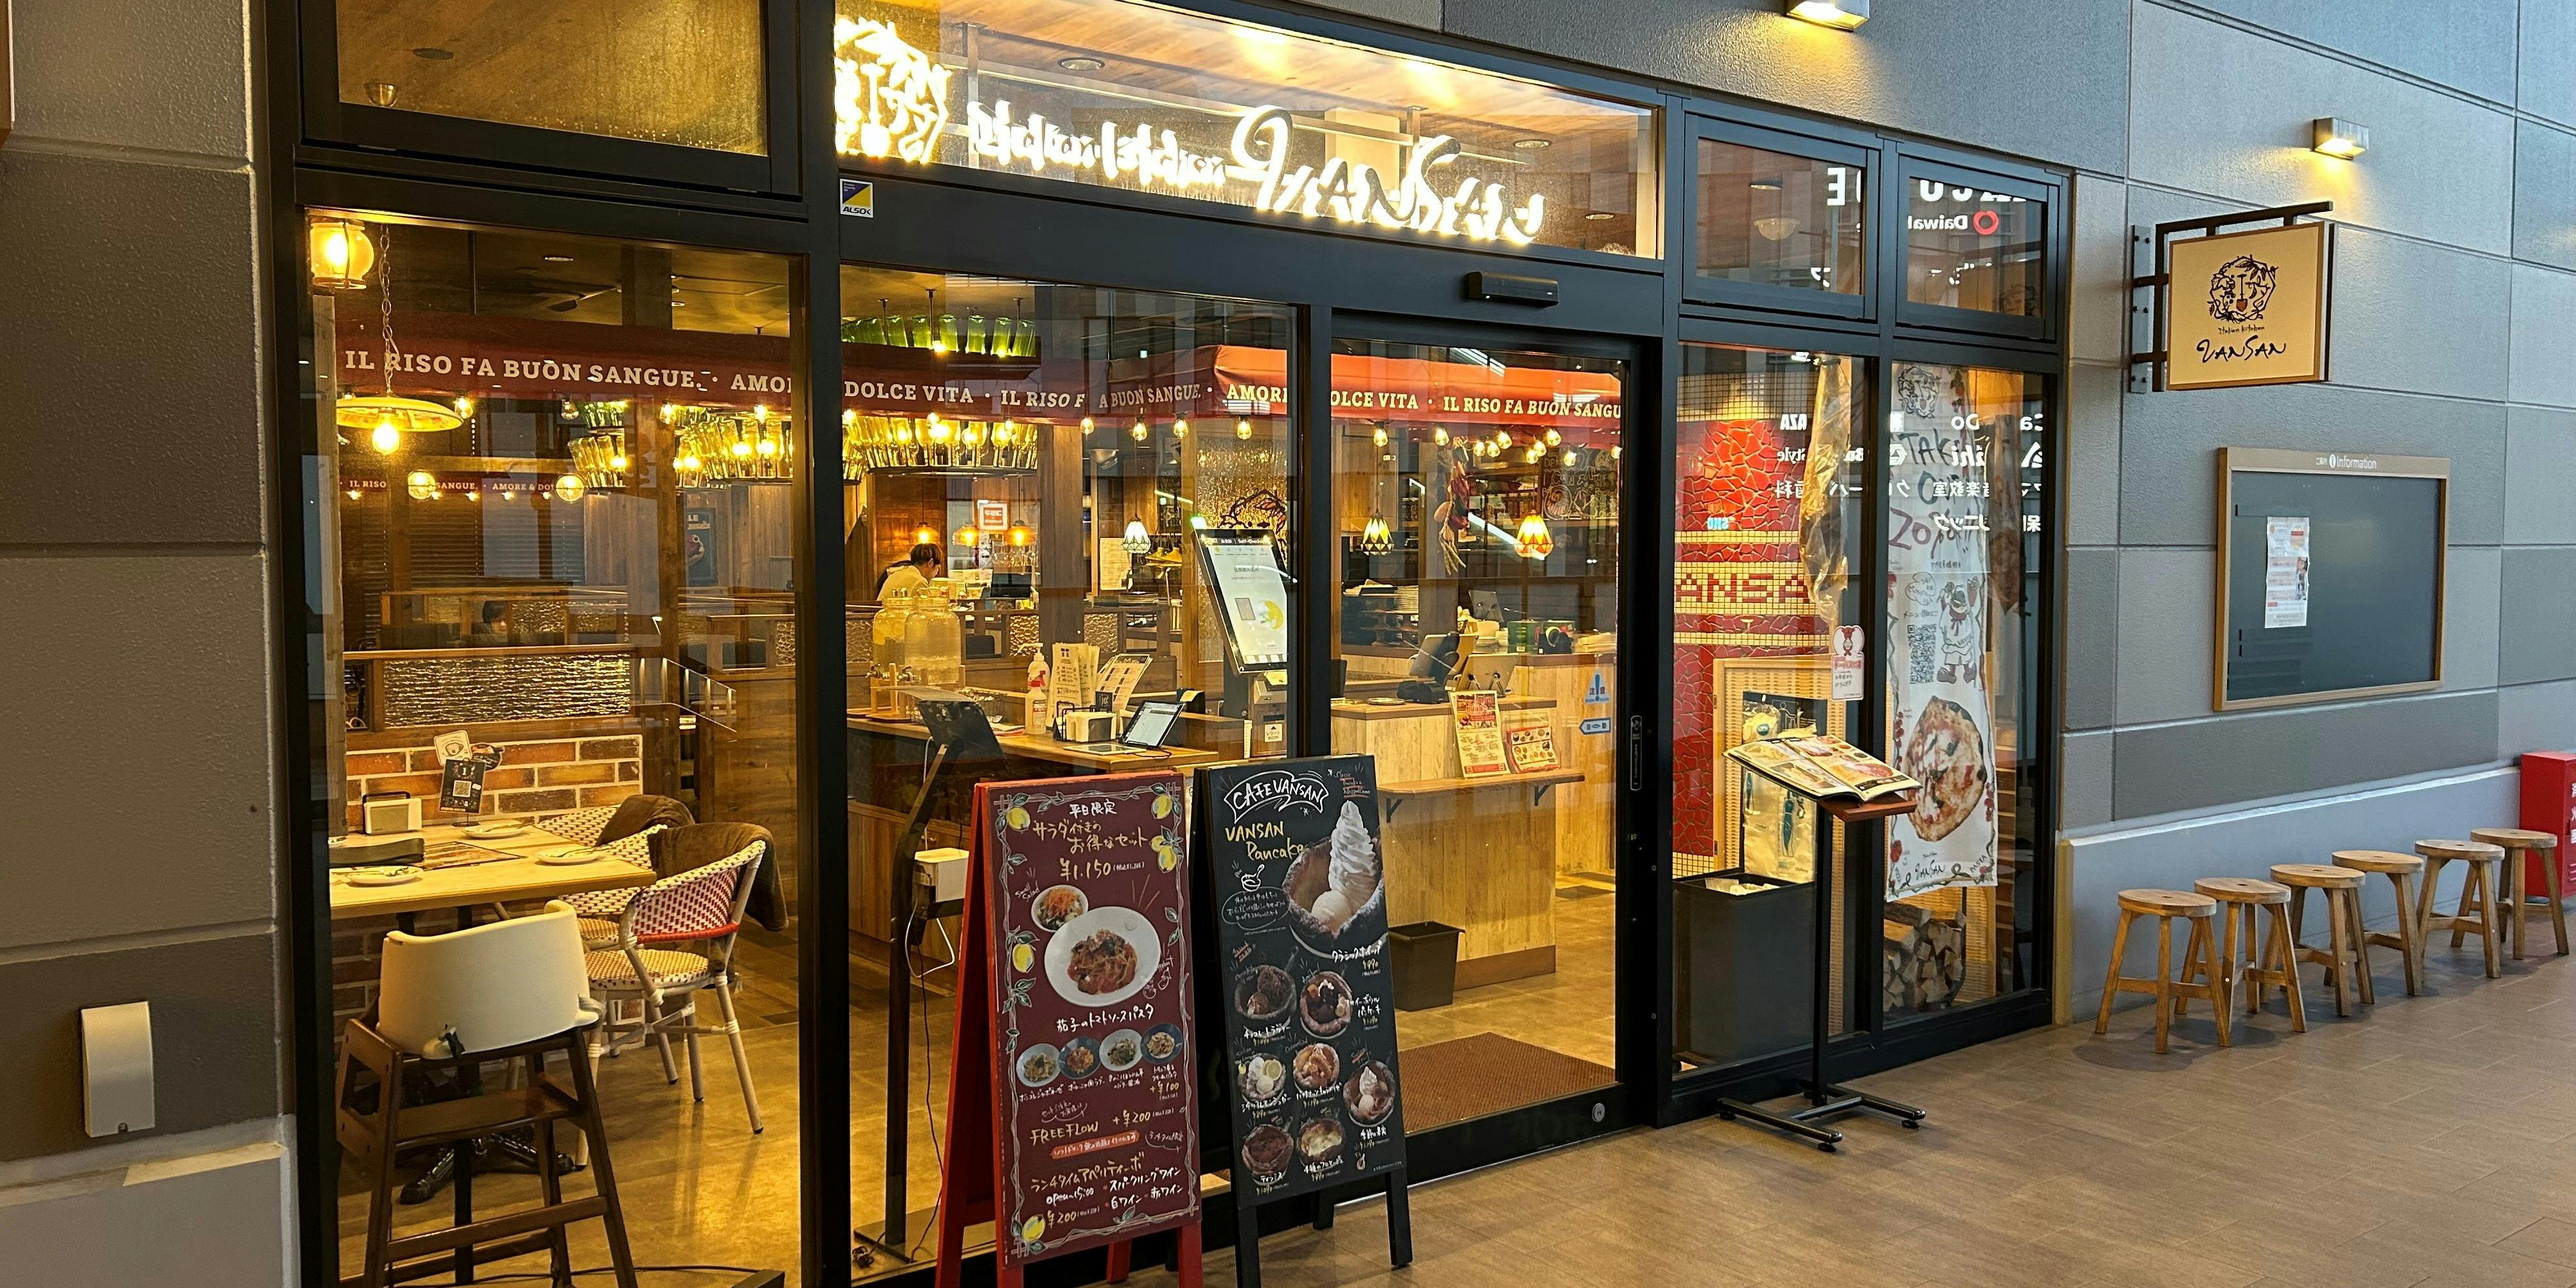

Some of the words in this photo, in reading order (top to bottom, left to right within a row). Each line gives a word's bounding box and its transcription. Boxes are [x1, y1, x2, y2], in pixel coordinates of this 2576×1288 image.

[1231, 105, 1546, 246] VANSAN
[843, 206, 871, 215] ALSOK
[2218, 326, 2239, 334] Italian
[2196, 335, 2286, 363] VANSAN
[346, 350, 374, 369] IL
[384, 353, 452, 374] RISO
[461, 357, 496, 377] FA
[588, 364, 702, 389] SANGUE.
[731, 373, 791, 393] AMO
[844, 381, 916, 401] DOLCE
[922, 385, 974, 404] VITA
[1000, 389, 1020, 406] IL
[1025, 391, 1071, 408] RISO
[1110, 388, 1144, 407] BUON
[1147, 383, 1201, 404] SANGUE.
[1378, 392, 1419, 410] VITA
[1443, 396, 1460, 412] IL
[1463, 397, 1501, 413] RISO
[1504, 399, 1524, 415] FA
[1527, 400, 1571, 416] BUON
[2336, 454, 2377, 470] Information
[493, 483, 526, 491] AMORE
[1233, 782, 1273, 809] CAFE
[1273, 778, 1324, 803] VANSAN
[1069, 799, 1117, 818] 平日限定
[1032, 818, 1101, 841] サラダ付きの
[1067, 827, 1148, 854] お得なセット
[1225, 820, 1284, 842] VANSAN
[1246, 837, 1305, 861] Pancake
[1056, 1003, 1154, 1033] 茄子のトマトソースパスタ
[1031, 1151, 1145, 1193] ランチタイムアペリティーボ
